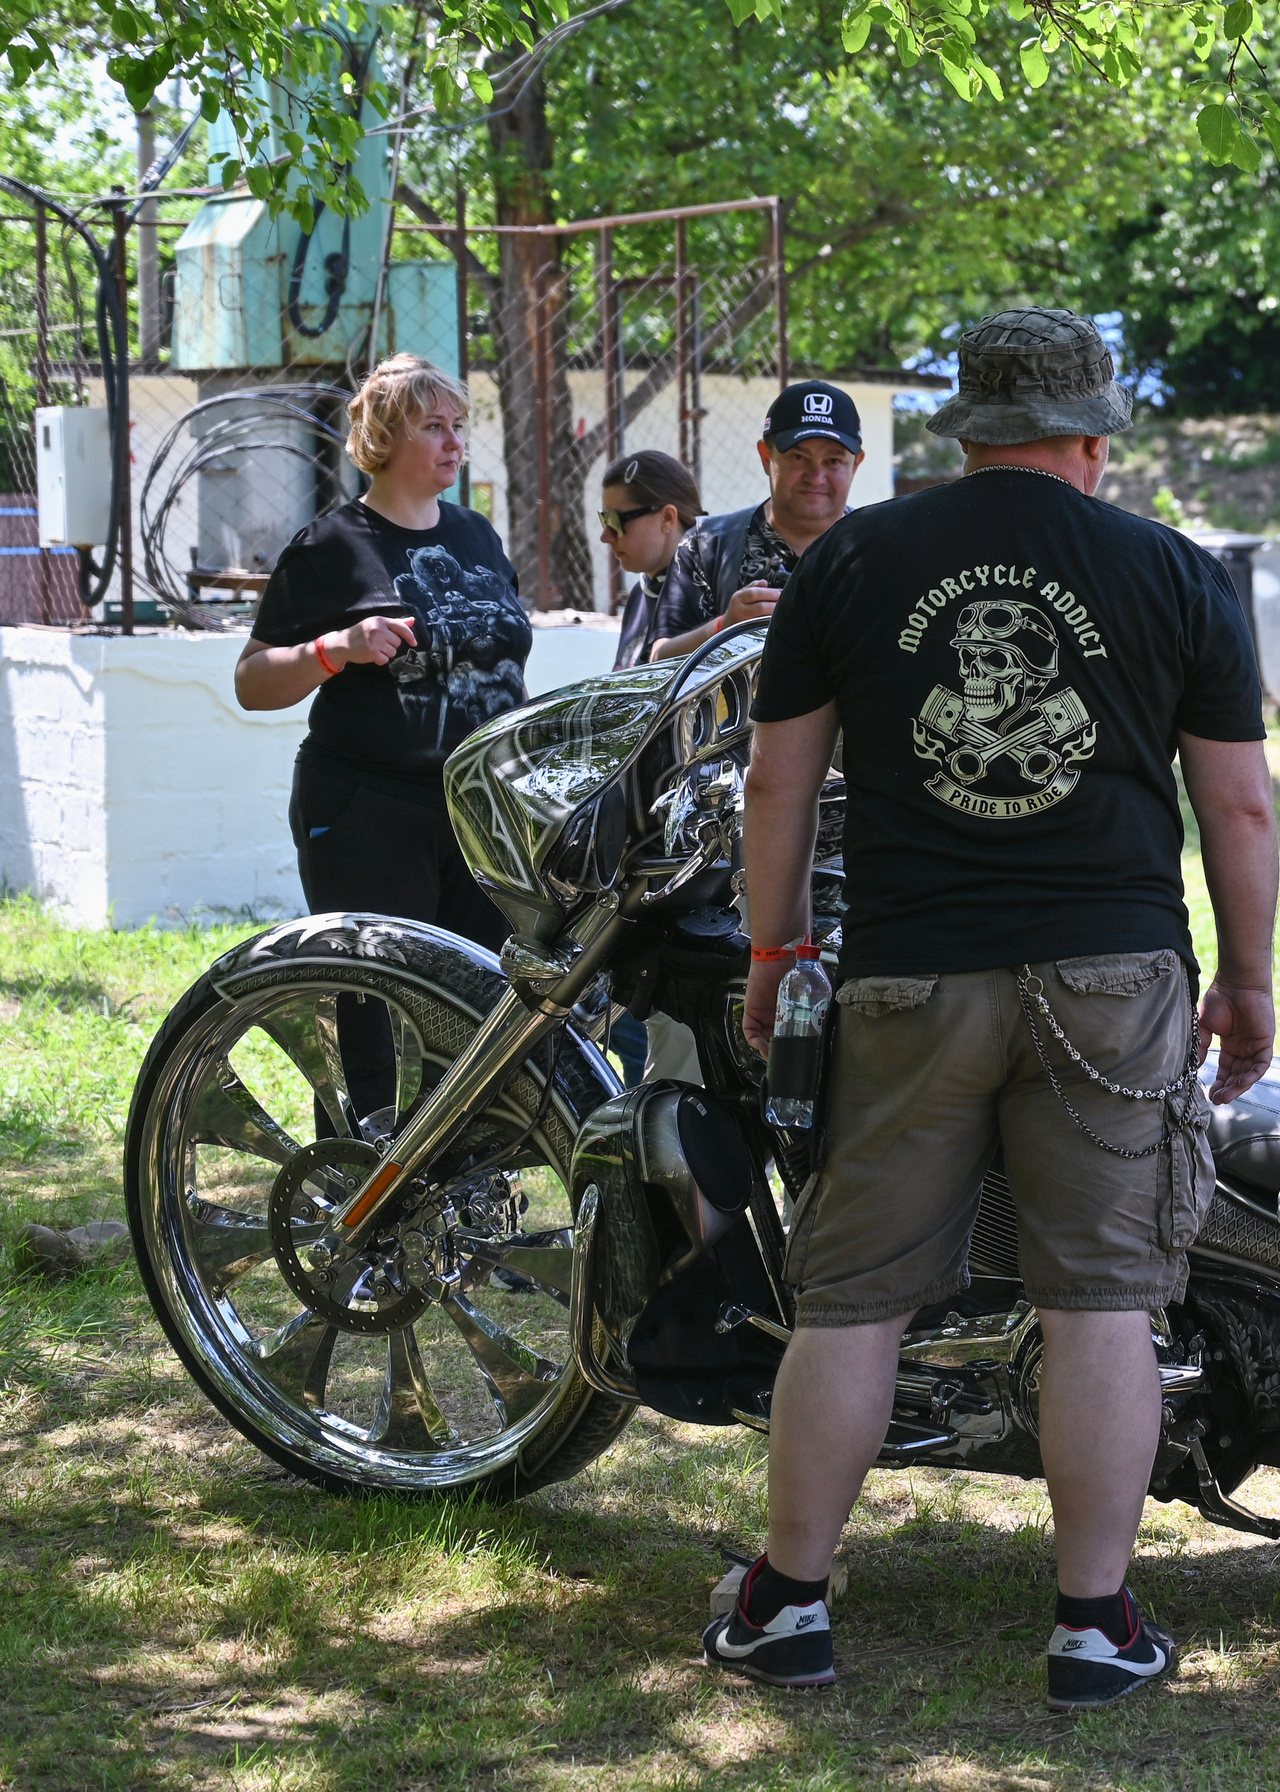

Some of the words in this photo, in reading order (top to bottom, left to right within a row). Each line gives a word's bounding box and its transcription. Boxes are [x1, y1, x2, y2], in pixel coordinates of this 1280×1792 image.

[801, 415, 834, 425] HONDA
[897, 563, 1037, 654] MOTORCYCLE
[1039, 581, 1108, 659] ADDICT
[949, 789, 997, 815] PRIDE
[1004, 801, 1021, 815] TO
[1028, 785, 1063, 811] RIDE
[798, 1613, 818, 1624] NIKE
[1065, 1638, 1087, 1649] NIKE
